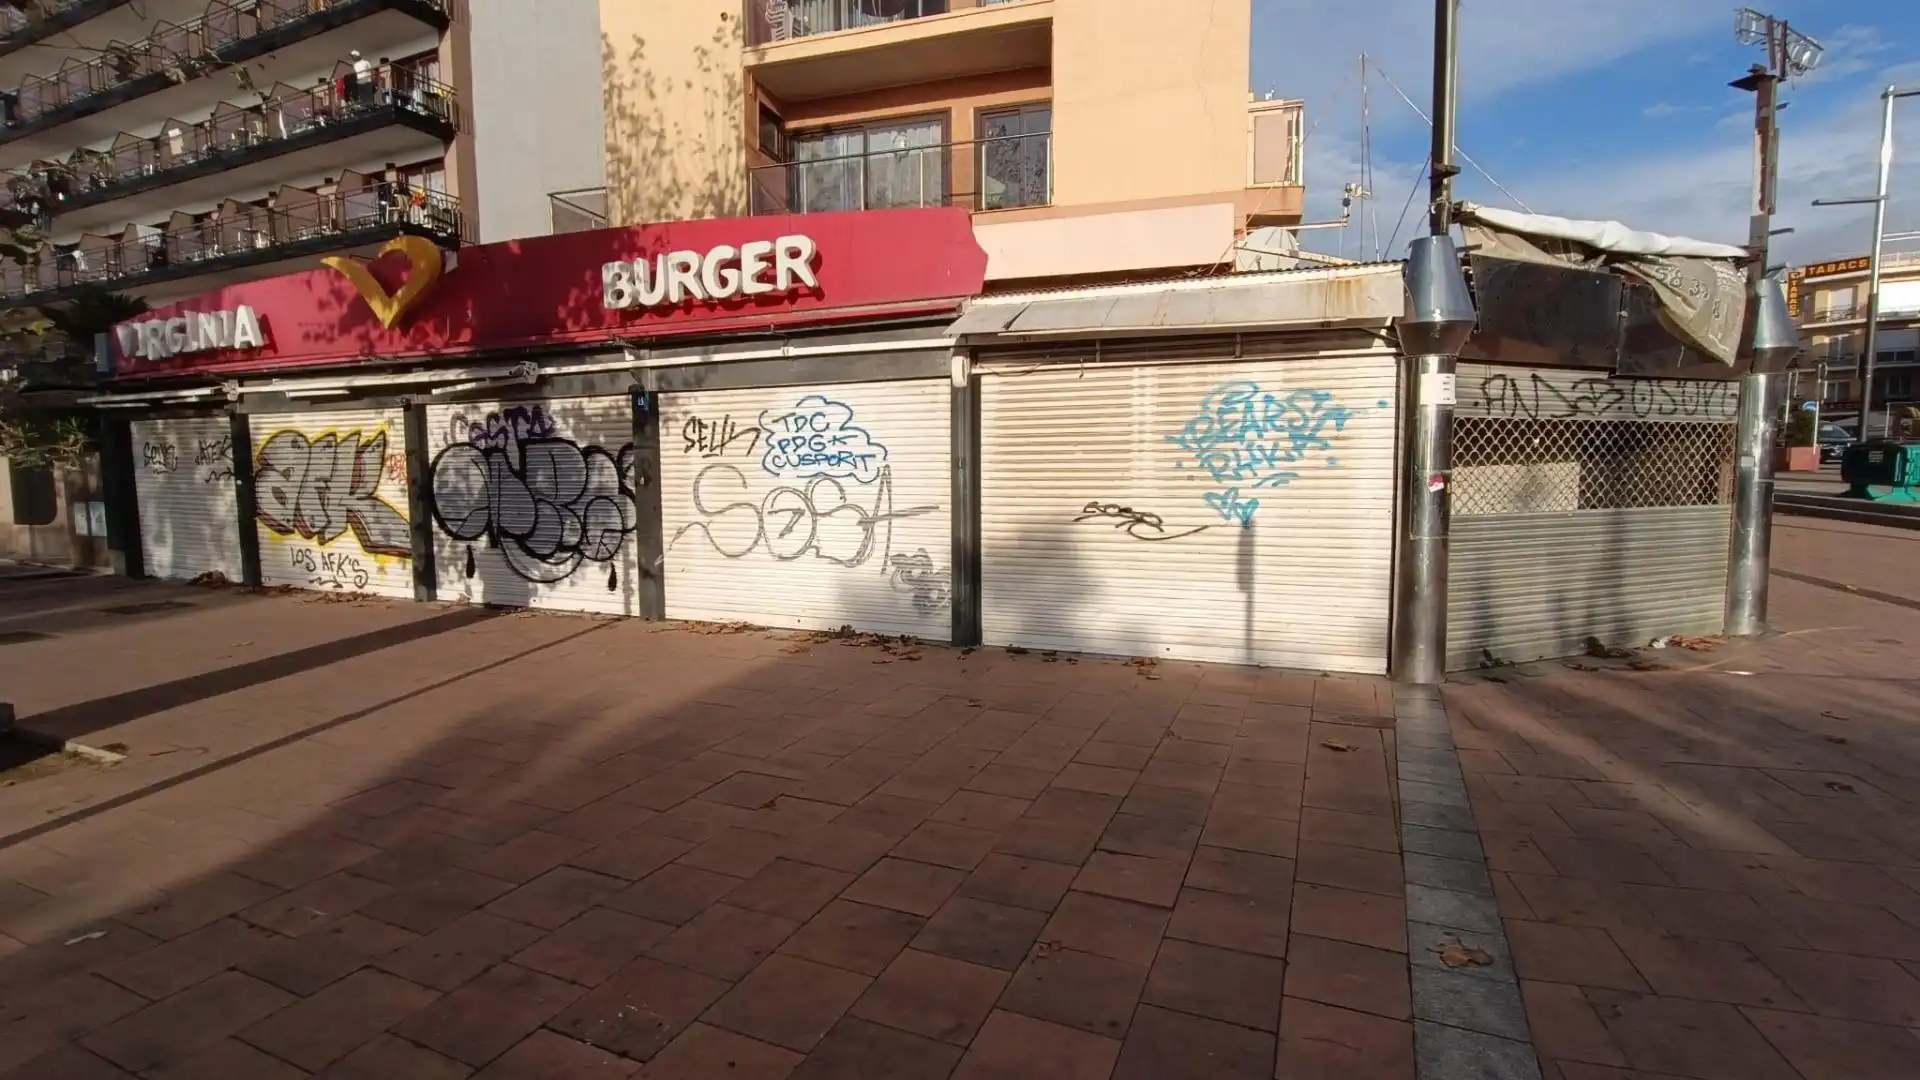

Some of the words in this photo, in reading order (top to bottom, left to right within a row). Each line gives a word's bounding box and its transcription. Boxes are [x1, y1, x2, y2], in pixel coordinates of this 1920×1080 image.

[601, 234, 818, 309] BURGER
[1808, 258, 1869, 275] TABACS
[116, 304, 263, 361] VIRGINIA
